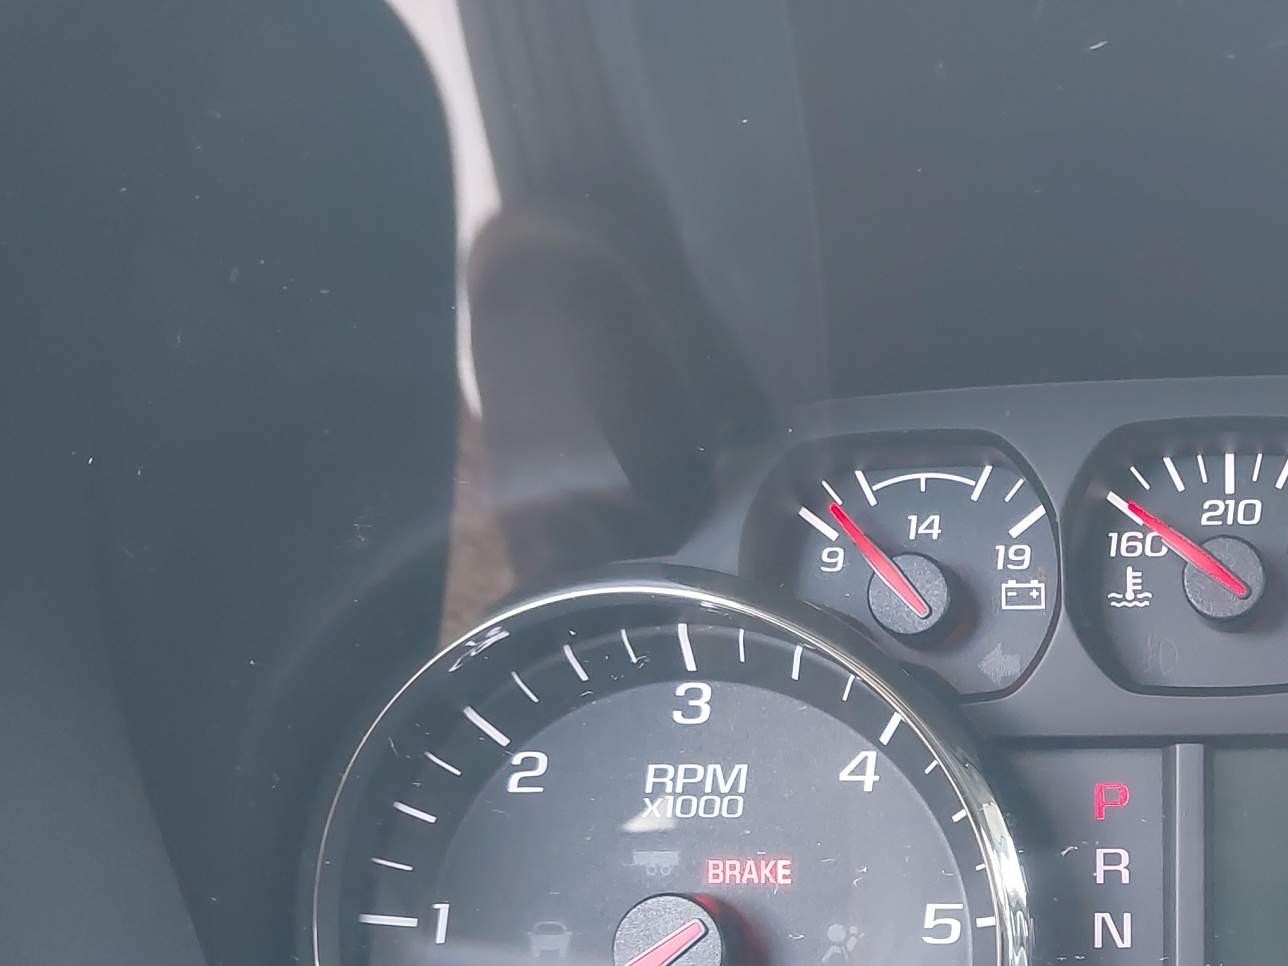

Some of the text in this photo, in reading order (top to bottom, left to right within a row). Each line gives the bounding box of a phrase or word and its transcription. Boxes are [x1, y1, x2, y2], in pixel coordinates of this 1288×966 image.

[907, 513, 943, 540] 14
[1200, 498, 1263, 526] 210
[819, 546, 844, 573] 9
[994, 543, 1032, 571] 19
[1107, 531, 1169, 558] 160
[671, 682, 713, 726] 3
[506, 750, 549, 794] 2
[644, 763, 749, 794] RPM
[838, 750, 880, 793] 4
[642, 795, 744, 818] x1000
[1094, 782, 1131, 821] P
[707, 859, 792, 886] BRAKE
[1094, 848, 1131, 885] R
[431, 903, 450, 944] 1
[921, 902, 965, 945] 5
[1092, 912, 1133, 949] N
